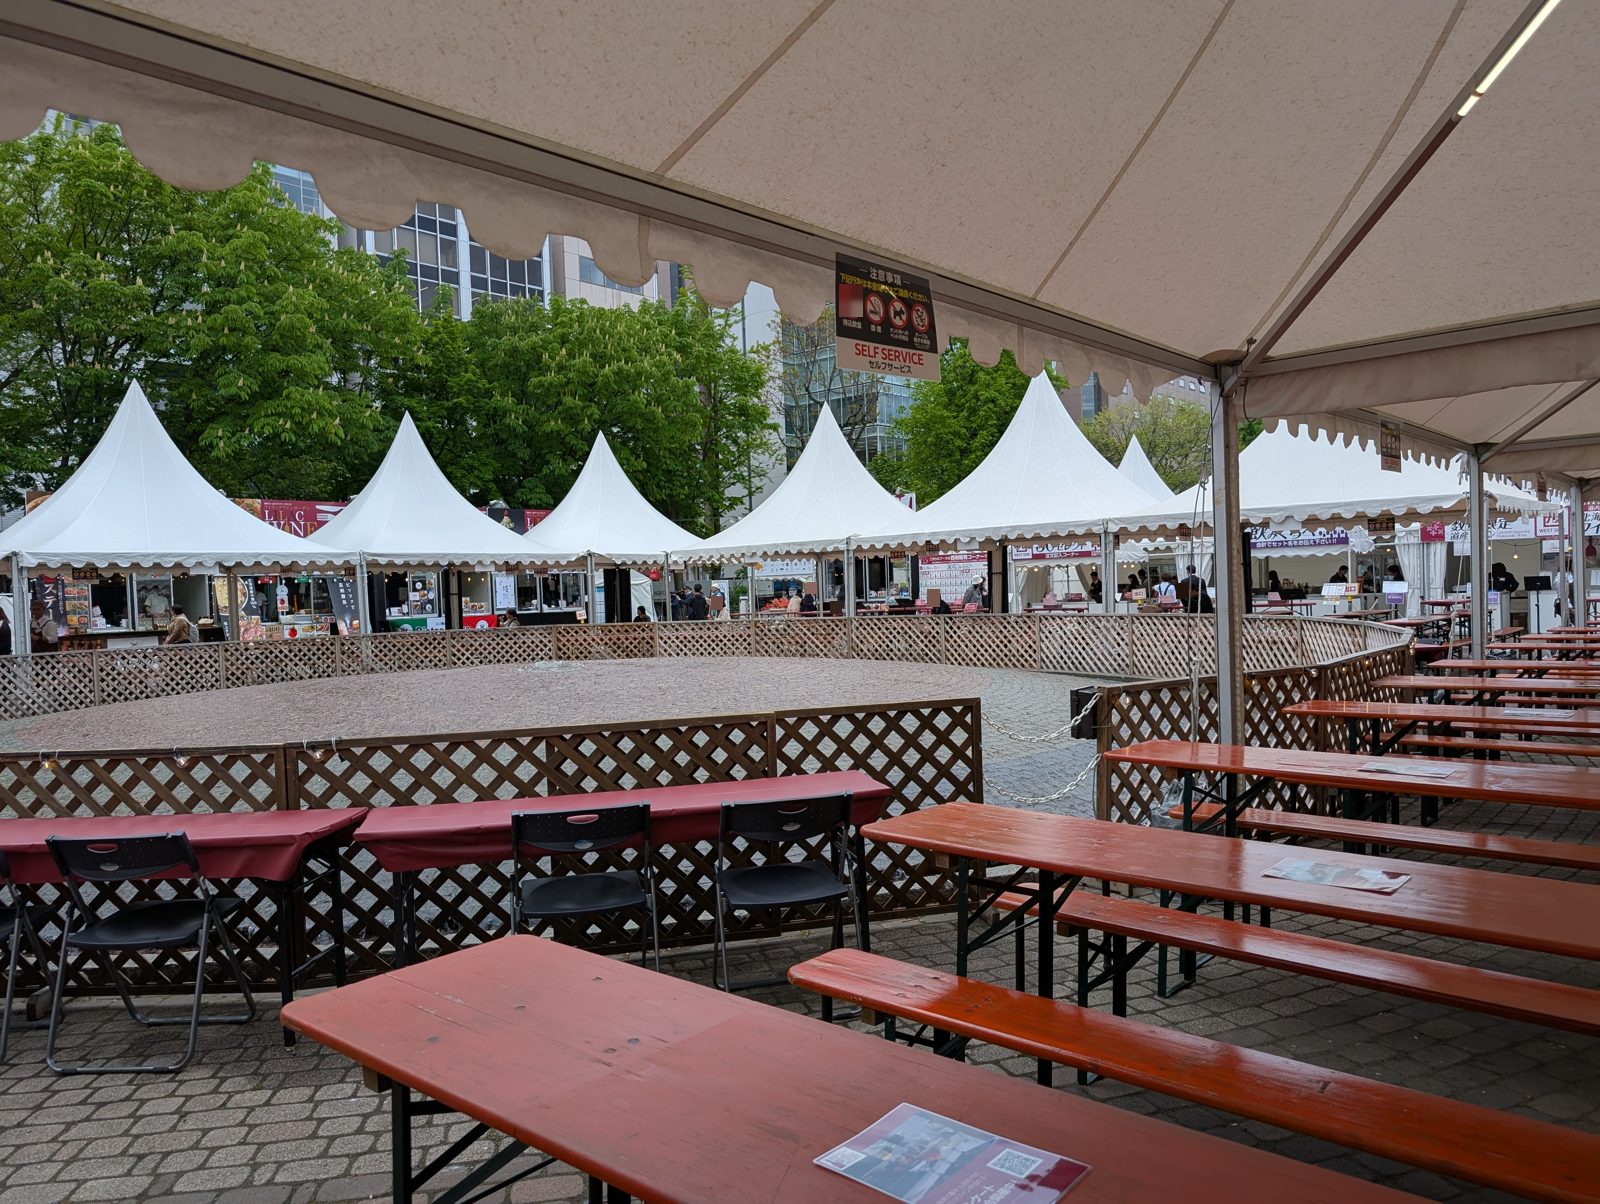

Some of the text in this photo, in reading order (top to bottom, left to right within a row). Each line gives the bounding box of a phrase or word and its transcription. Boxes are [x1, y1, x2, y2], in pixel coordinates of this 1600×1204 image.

[854, 343, 924, 366] SELF SERVICE
[868, 360, 913, 374] セルフサービス
[264, 510, 304, 521] LILAC
